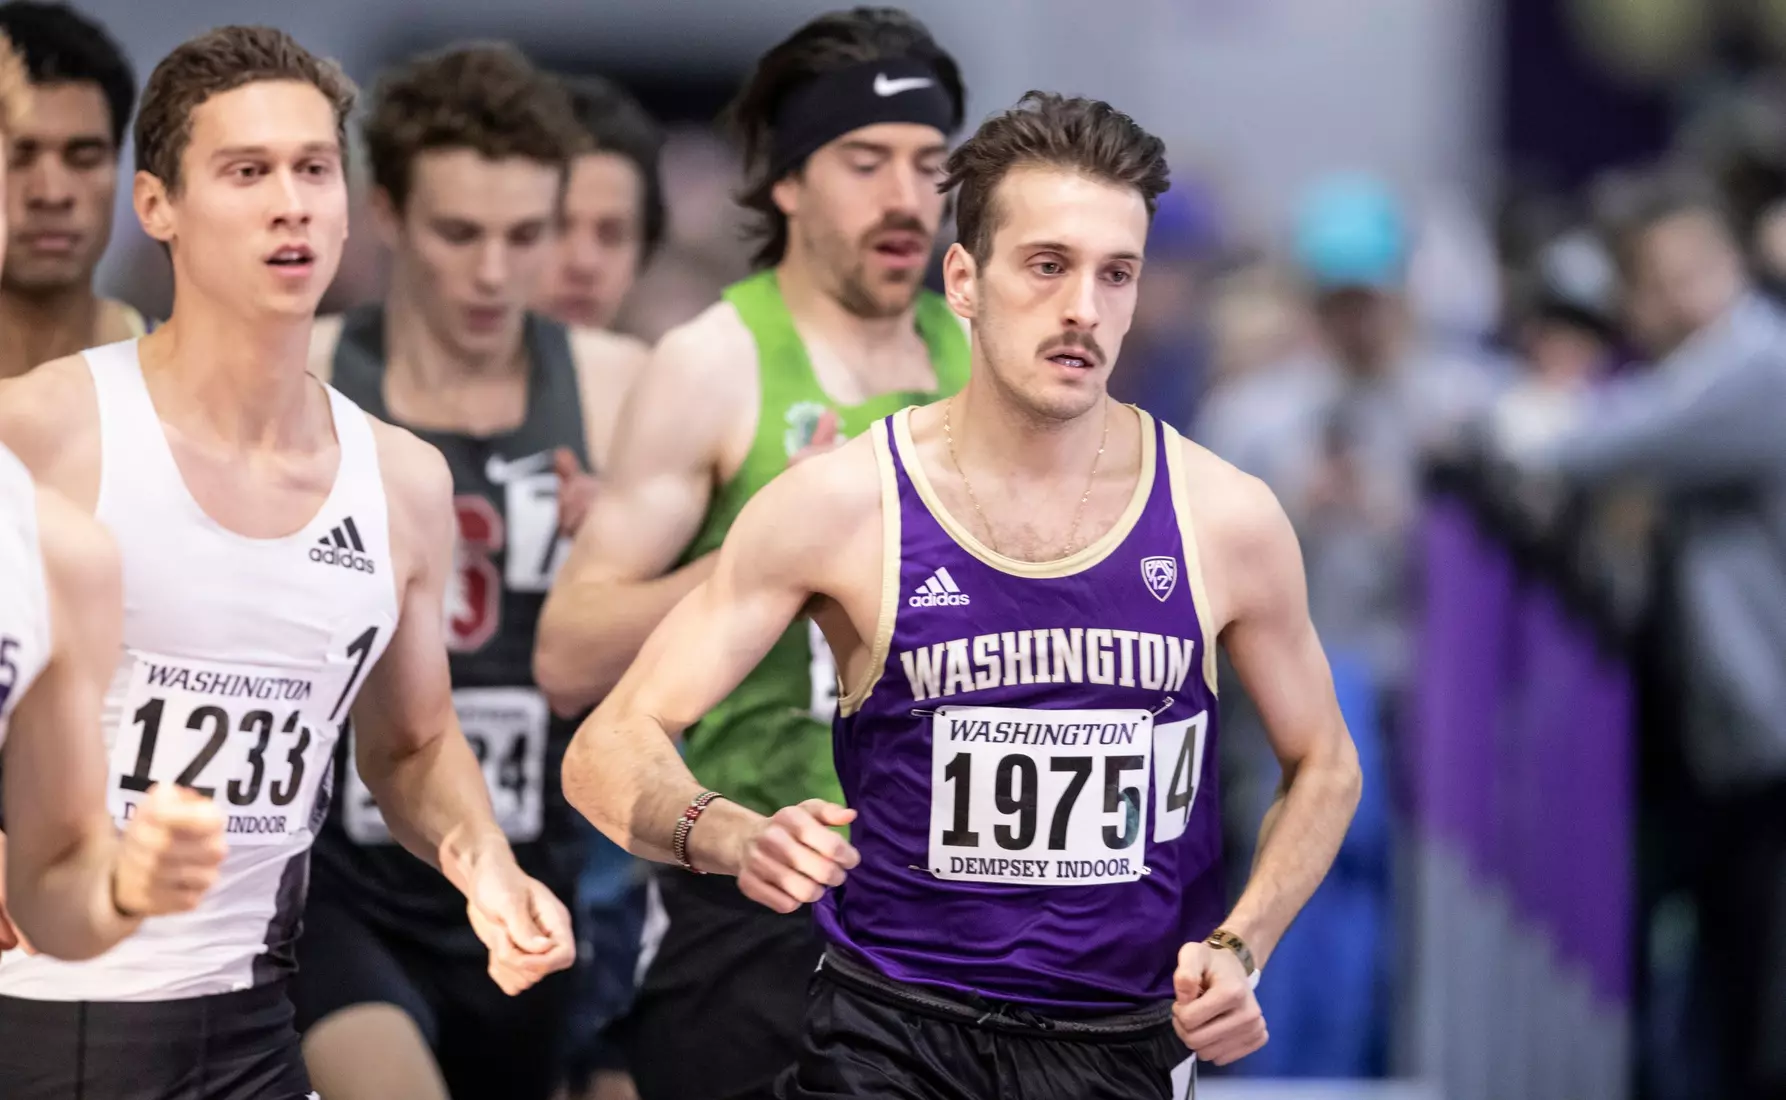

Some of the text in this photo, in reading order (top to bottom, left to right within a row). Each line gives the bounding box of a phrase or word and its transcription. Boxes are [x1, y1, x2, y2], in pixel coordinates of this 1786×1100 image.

[308, 545, 375, 575] adidas
[1153, 575, 1169, 590] 12
[908, 591, 971, 608] adidas
[327, 625, 379, 721] 1
[900, 628, 1195, 701] WASHINGTON
[950, 720, 1138, 746] WASHINGTON
[119, 697, 311, 807] 1233
[1166, 725, 1196, 825] 4
[942, 751, 1145, 851] 1975
[227, 815, 287, 835] INDOOR
[950, 856, 1131, 878] DEMPSEY INDOOR
